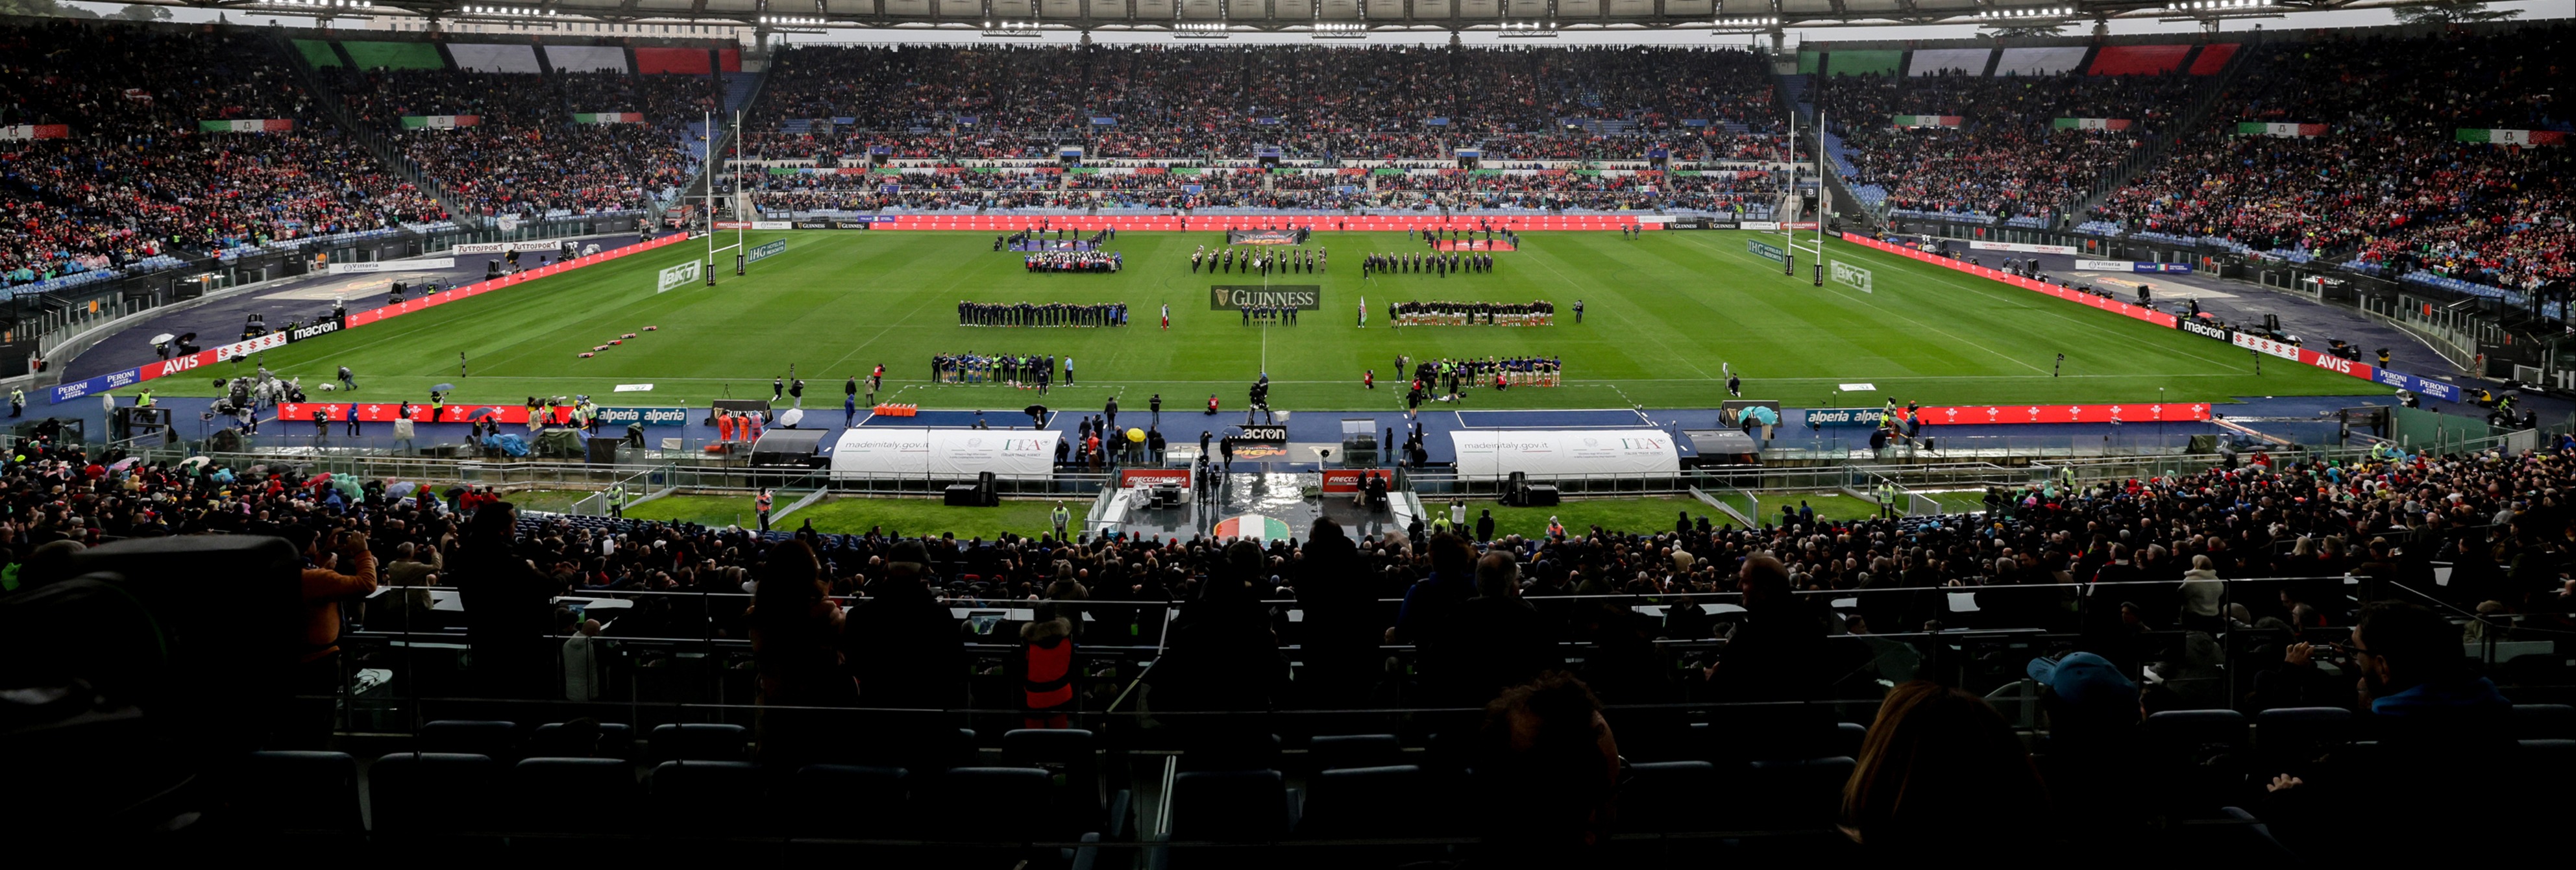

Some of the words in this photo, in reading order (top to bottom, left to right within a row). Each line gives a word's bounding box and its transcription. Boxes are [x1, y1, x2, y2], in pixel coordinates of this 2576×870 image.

[458, 243, 504, 252] TUTTOSPORT
[512, 241, 557, 250] TUTTOSPORT
[1748, 241, 1763, 255] IHG
[750, 246, 766, 260] IHG
[665, 265, 694, 285] BKT
[1837, 266, 1864, 285] BKT
[1232, 290, 1314, 306] GUINNESS
[294, 321, 337, 340] macron
[2184, 321, 2225, 340] macron
[162, 354, 199, 375] AVIS
[2316, 354, 2350, 374] AVIS
[107, 370, 135, 382] PERONI
[2380, 369, 2407, 382] PERONI
[58, 382, 88, 395] PERONI
[2420, 379, 2449, 393] PERONI
[598, 408, 639, 423] alperia
[644, 408, 685, 423] alperia
[1808, 410, 1849, 424] alperia
[1854, 410, 1883, 424] alper
[845, 441, 929, 450] madeinitaly.gov.it
[1003, 439, 1041, 451] ITA
[1620, 438, 1662, 449] ITA
